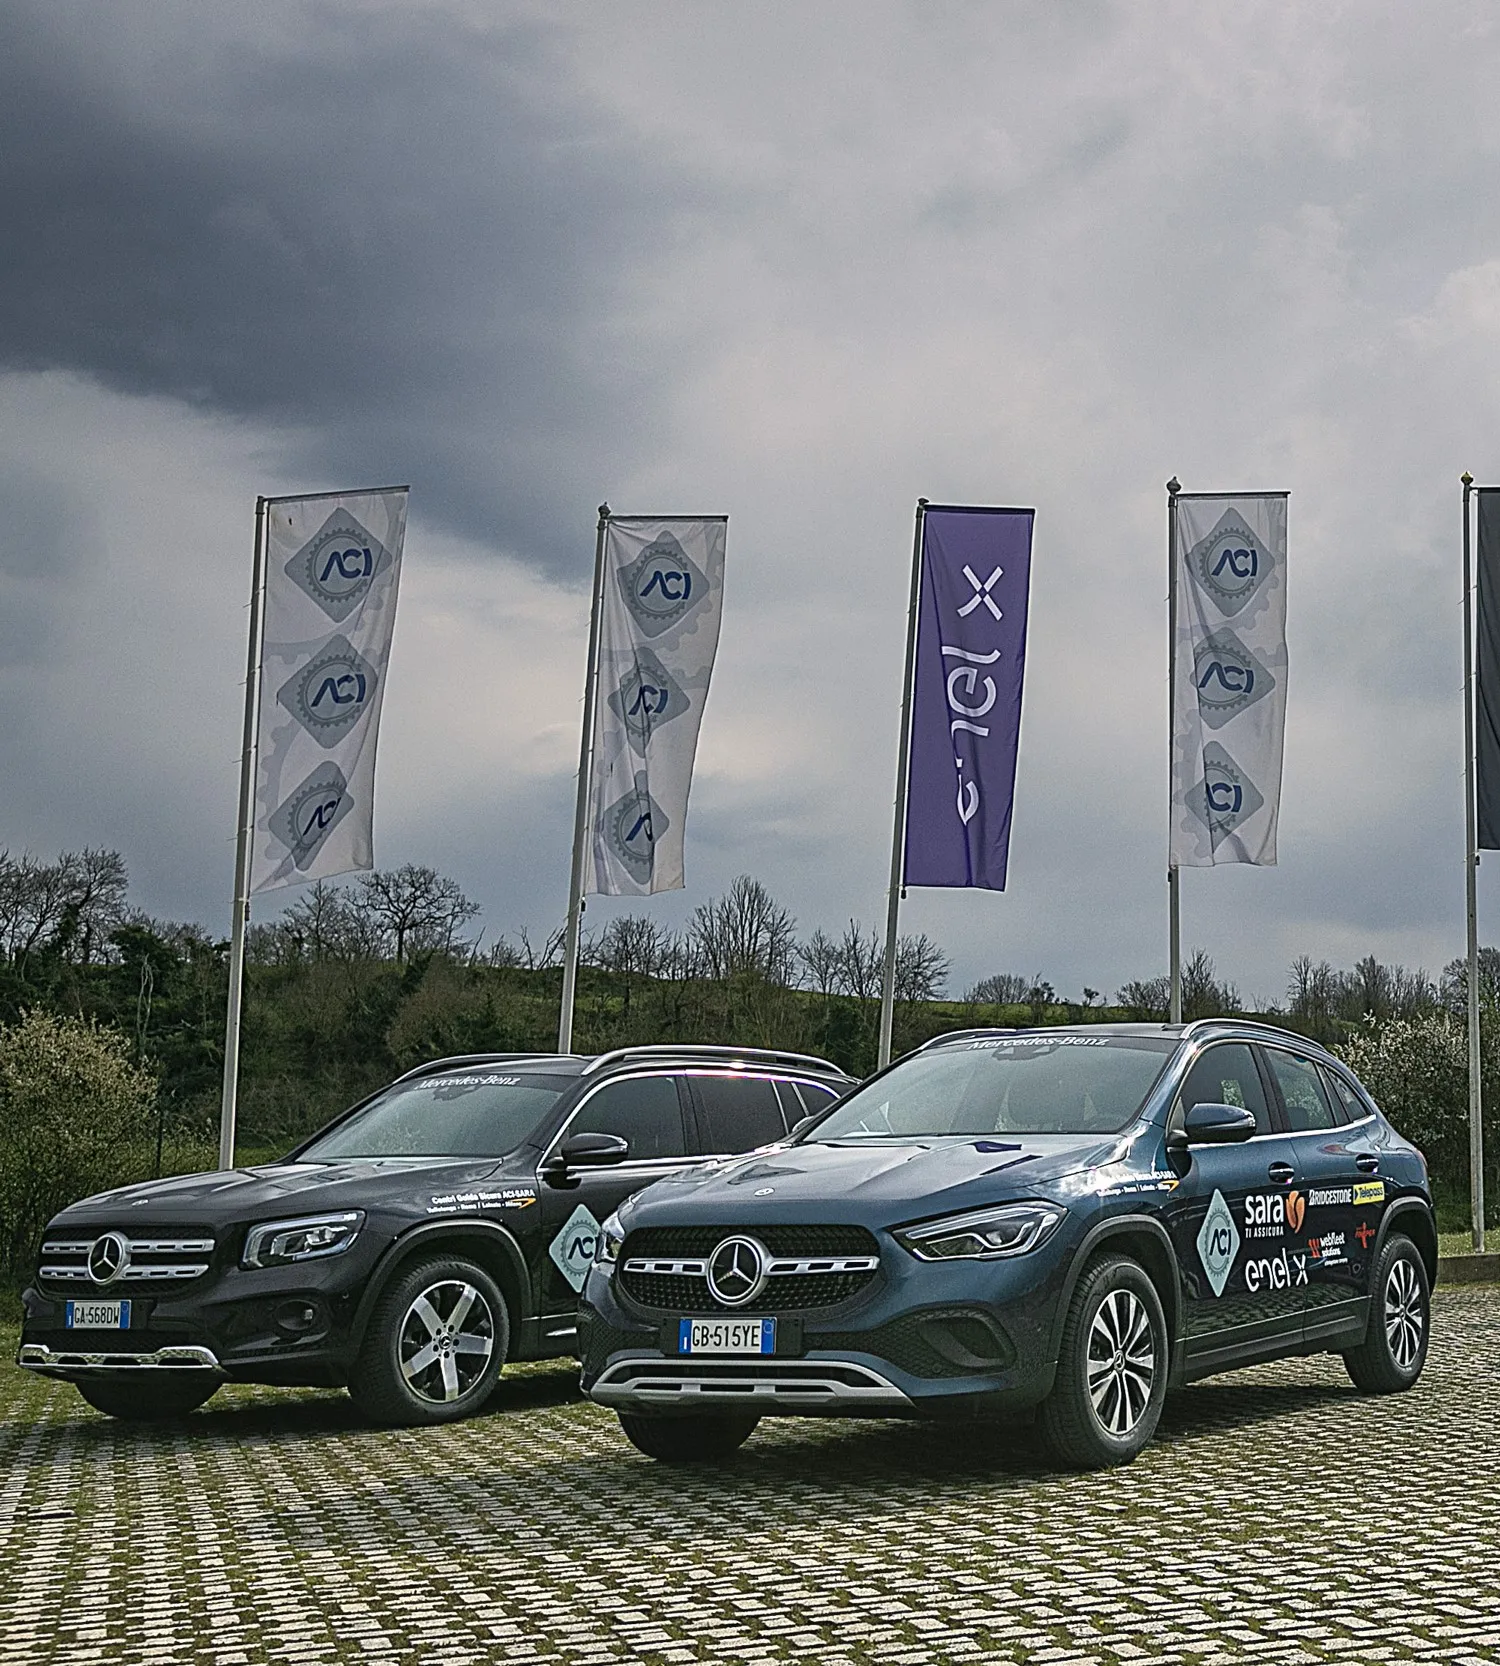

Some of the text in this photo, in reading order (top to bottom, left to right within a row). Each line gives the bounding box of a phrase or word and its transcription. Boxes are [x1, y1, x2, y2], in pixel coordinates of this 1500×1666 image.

[320, 548, 372, 581] ACI
[1211, 549, 1257, 577] ACI
[639, 571, 691, 600] ACI
[311, 674, 366, 707] ACI
[1198, 661, 1254, 693] ACI
[1245, 1195, 1284, 1225] sara
[1308, 1189, 1352, 1206] BRIDGESTONE
[1209, 1228, 1232, 1256] ACI
[1245, 1226, 1284, 1238] TI ASSICURA
[1245, 1247, 1291, 1292] enel
